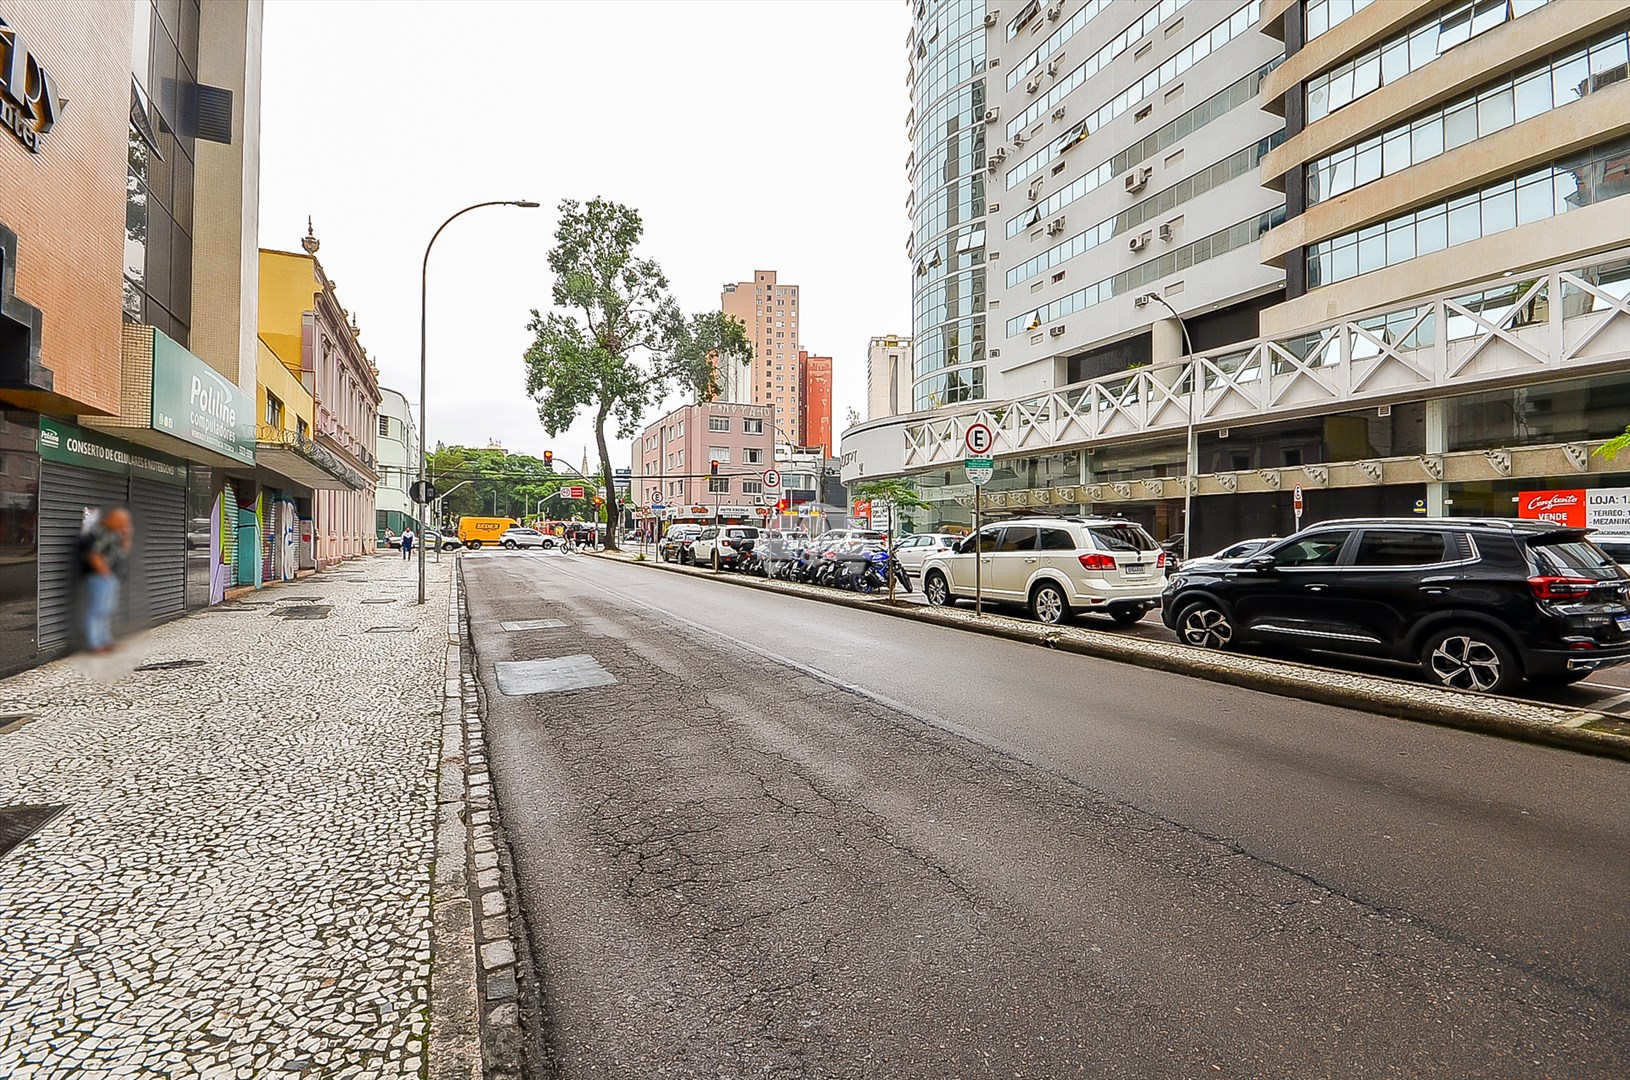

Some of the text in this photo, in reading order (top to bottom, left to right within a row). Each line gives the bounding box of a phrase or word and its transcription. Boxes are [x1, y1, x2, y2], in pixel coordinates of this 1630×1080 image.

[190, 375, 236, 427] Poliline
[190, 411, 236, 443] computadores
[974, 430, 984, 447] E
[66, 438, 104, 458] CONSERTO
[105, 449, 113, 461] DE
[113, 450, 144, 468] CELULARES
[769, 473, 775, 483] E
[655, 493, 660, 501] E
[1296, 486, 1300, 497] E
[1589, 495, 1618, 504] LOJA:
[1538, 512, 1568, 521] VENDE
